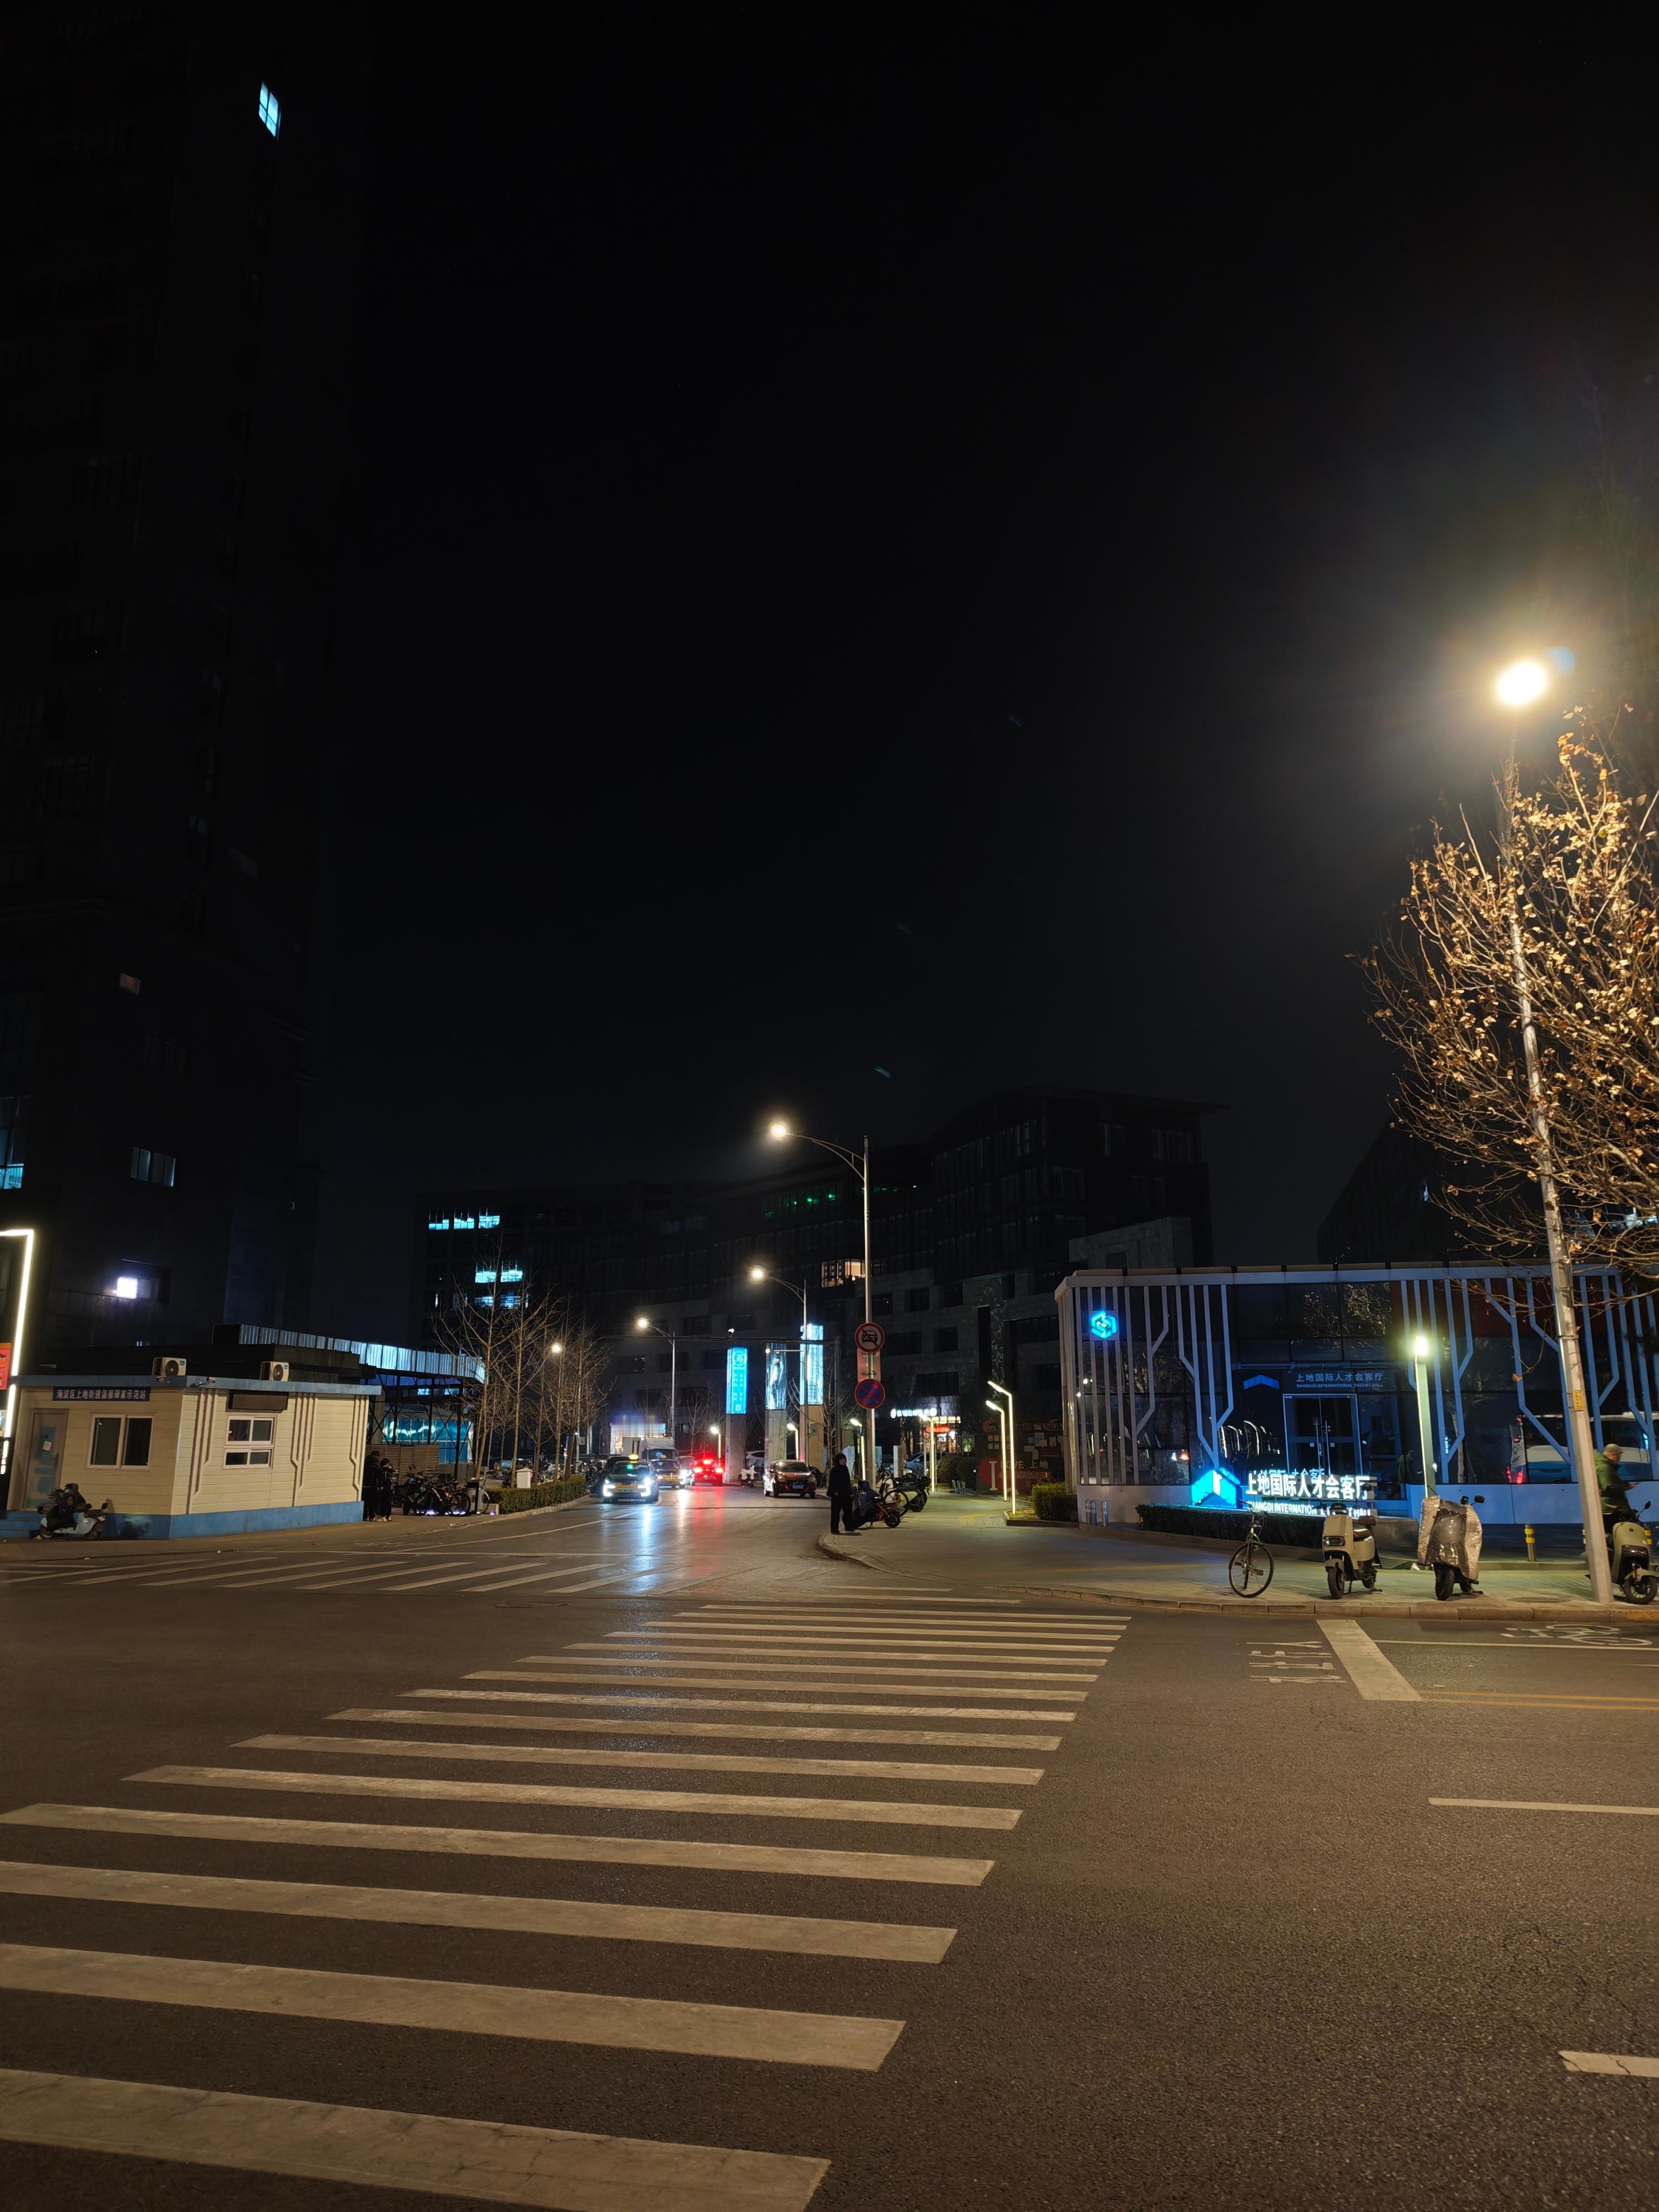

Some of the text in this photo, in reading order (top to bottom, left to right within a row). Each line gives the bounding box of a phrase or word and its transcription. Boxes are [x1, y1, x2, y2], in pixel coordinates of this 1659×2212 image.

[1296, 1373, 1383, 1382] 上地国际人才会客厅
[1029, 1459, 1049, 1469] 上地
[1245, 1473, 1370, 1500] 上地国际人才会客厅
[1274, 1502, 1325, 1516] INTERNATIONL
